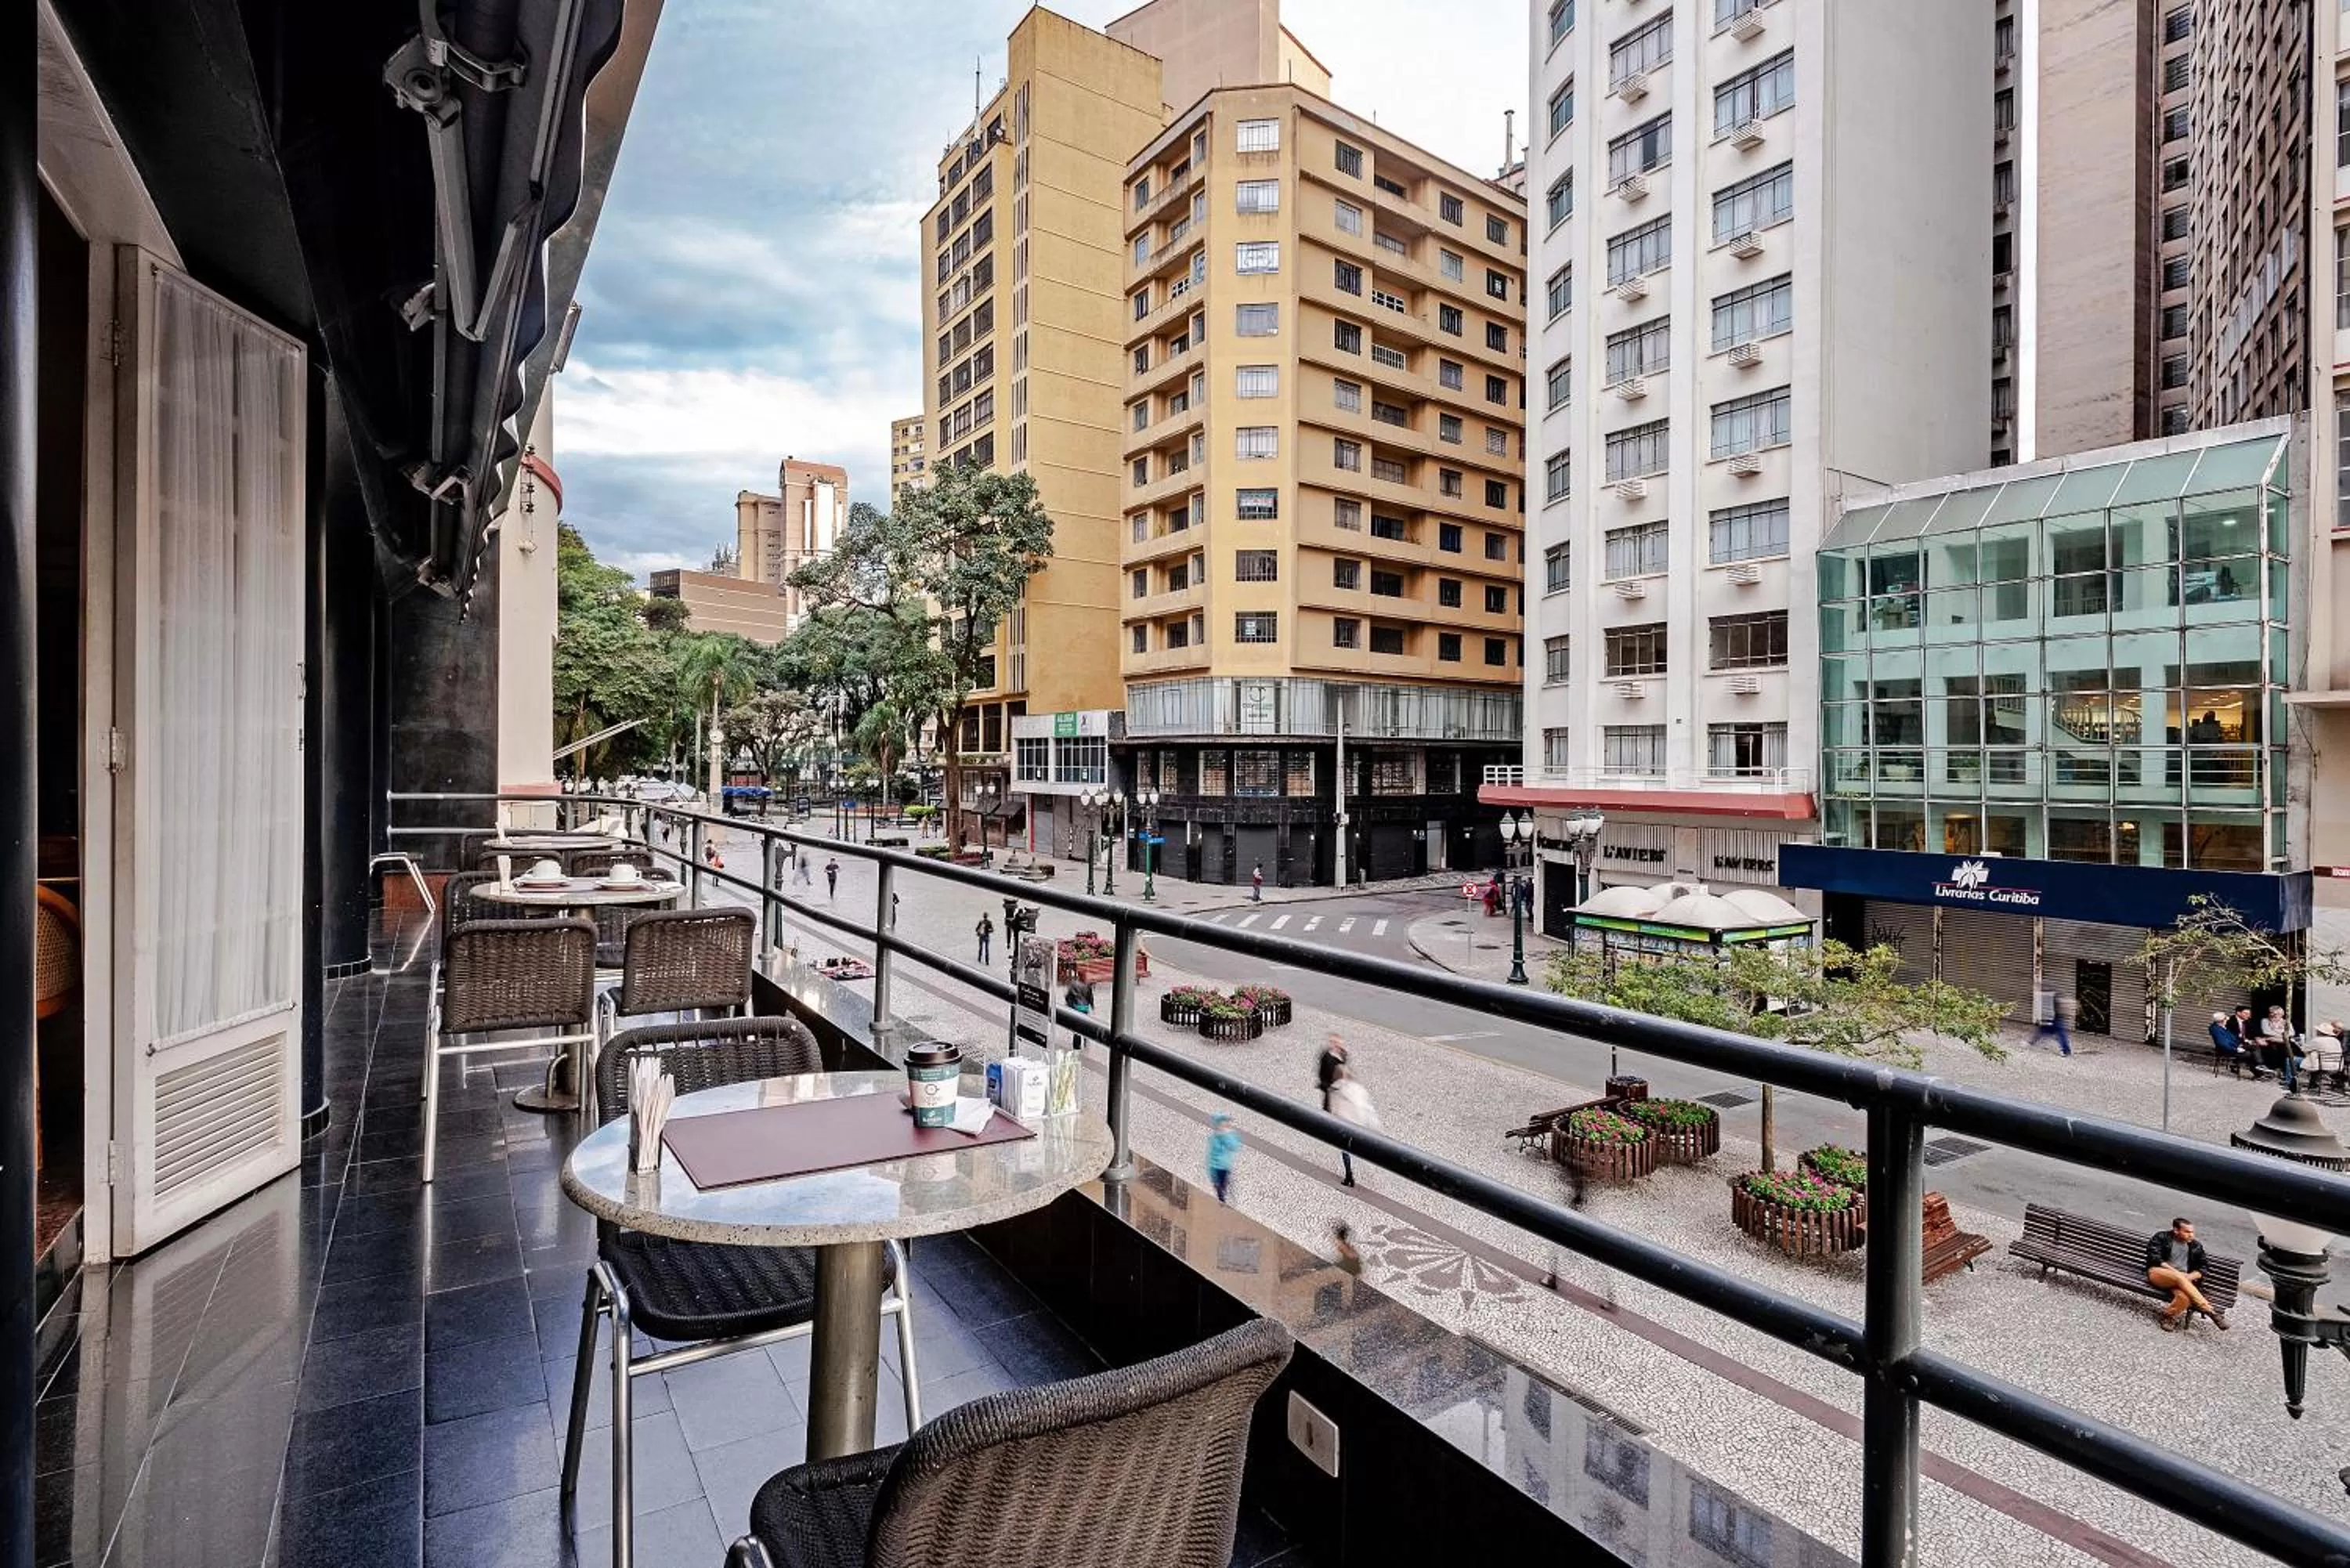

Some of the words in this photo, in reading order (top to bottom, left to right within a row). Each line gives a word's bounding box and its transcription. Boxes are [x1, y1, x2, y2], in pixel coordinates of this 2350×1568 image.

[1603, 845, 1665, 862] L'AVIERS
[1935, 884, 1985, 900] Livrarias
[1989, 889, 2040, 905] Curitiba
